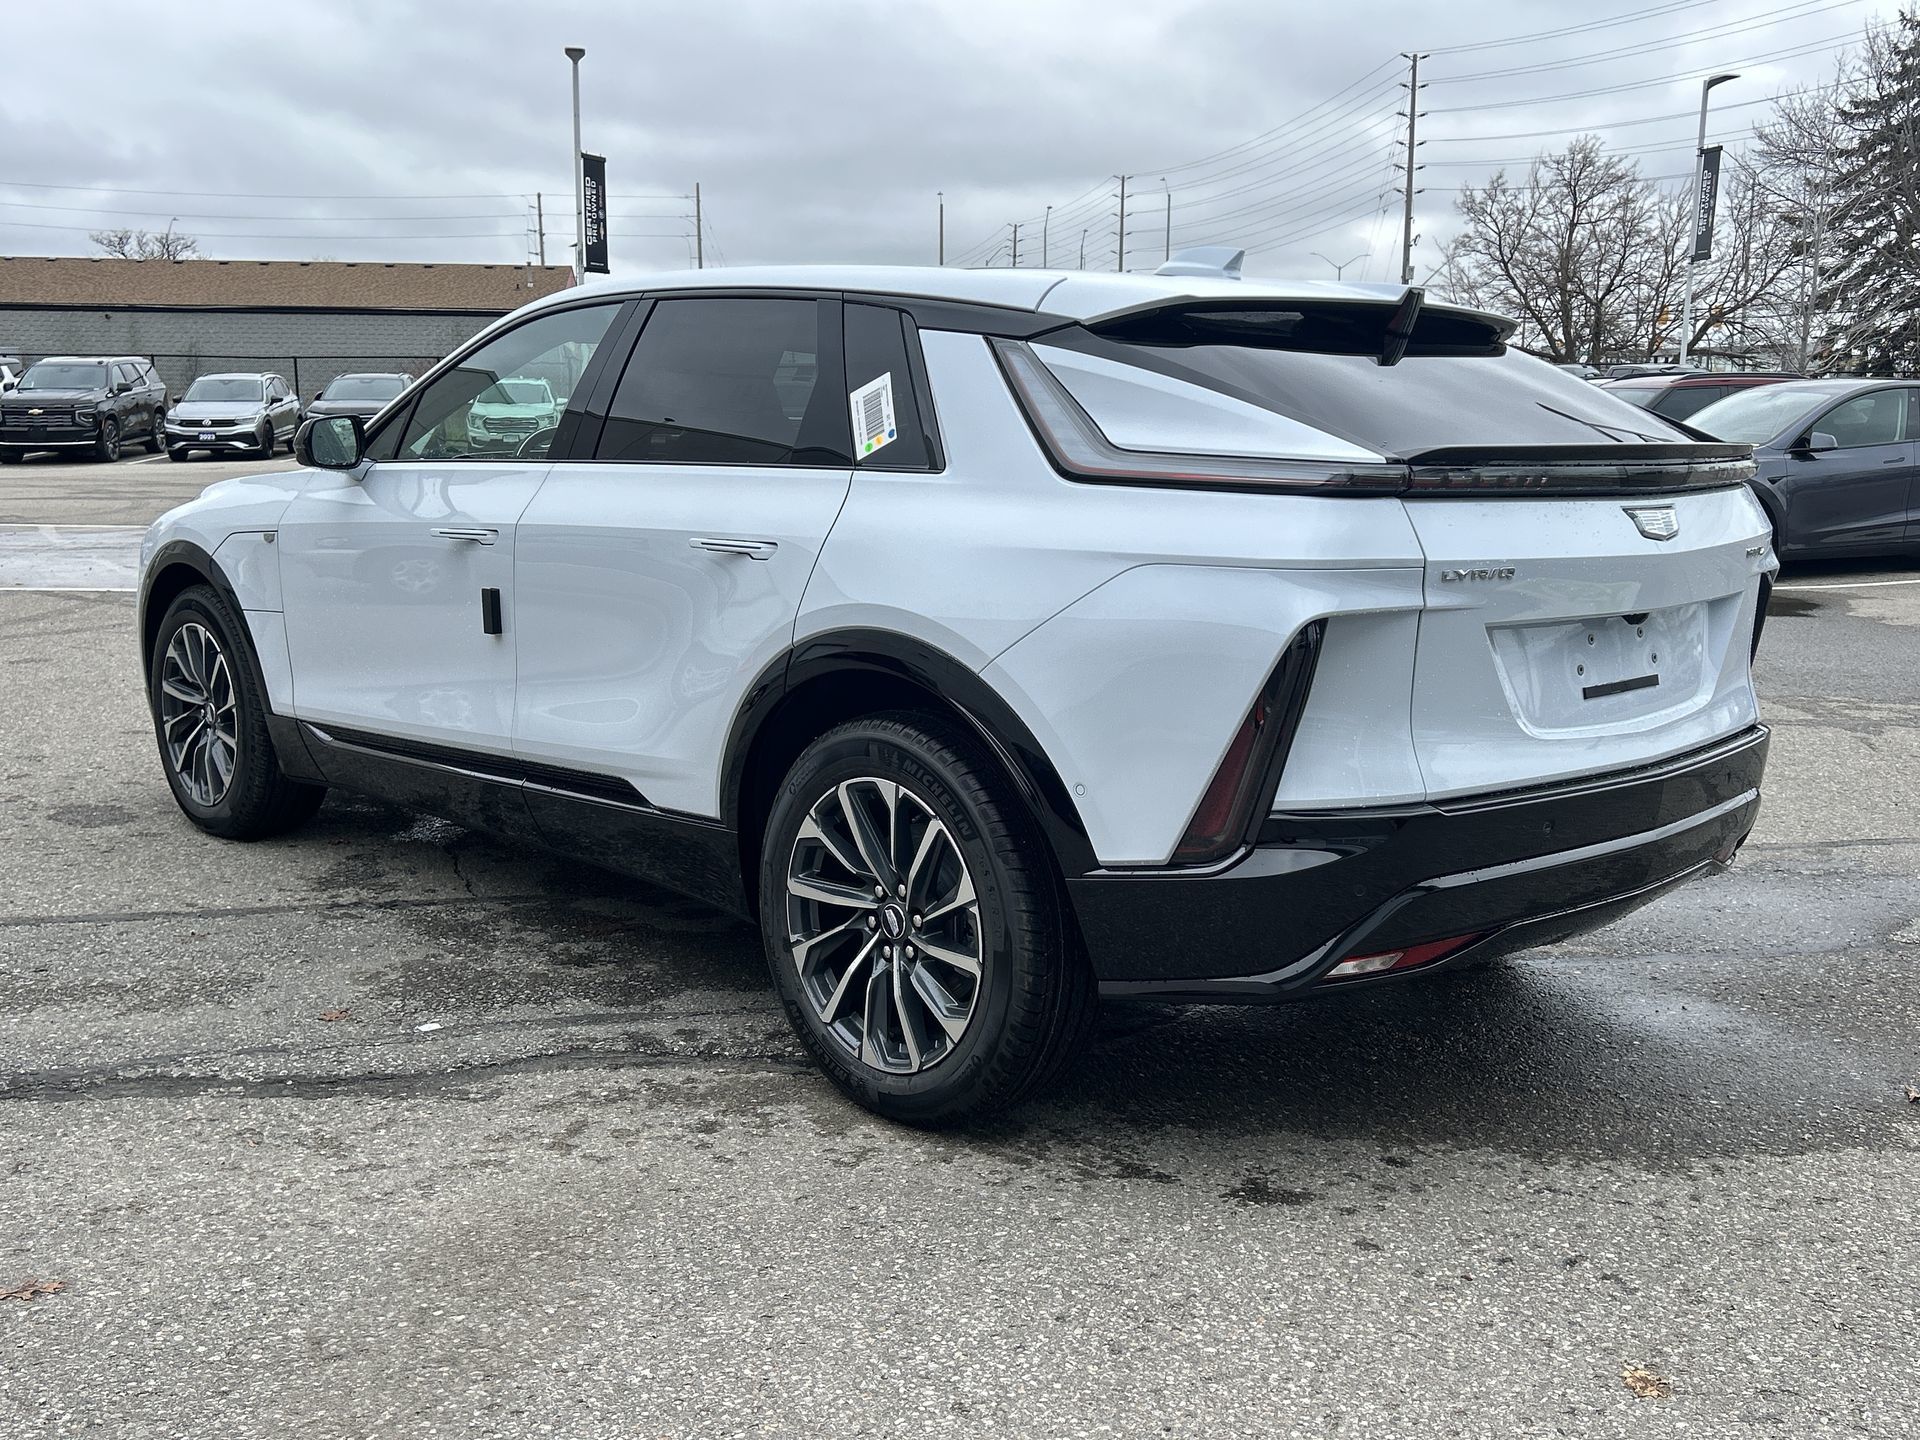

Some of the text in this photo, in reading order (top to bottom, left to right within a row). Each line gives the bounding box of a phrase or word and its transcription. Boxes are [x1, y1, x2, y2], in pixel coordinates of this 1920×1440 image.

[585, 176, 593, 245] CERTIFIED
[590, 180, 598, 243] PRE-OWNED
[198, 433, 216, 441] 2023
[1441, 566, 1516, 582] LYRIQ
[902, 757, 972, 837] MICHELIN
